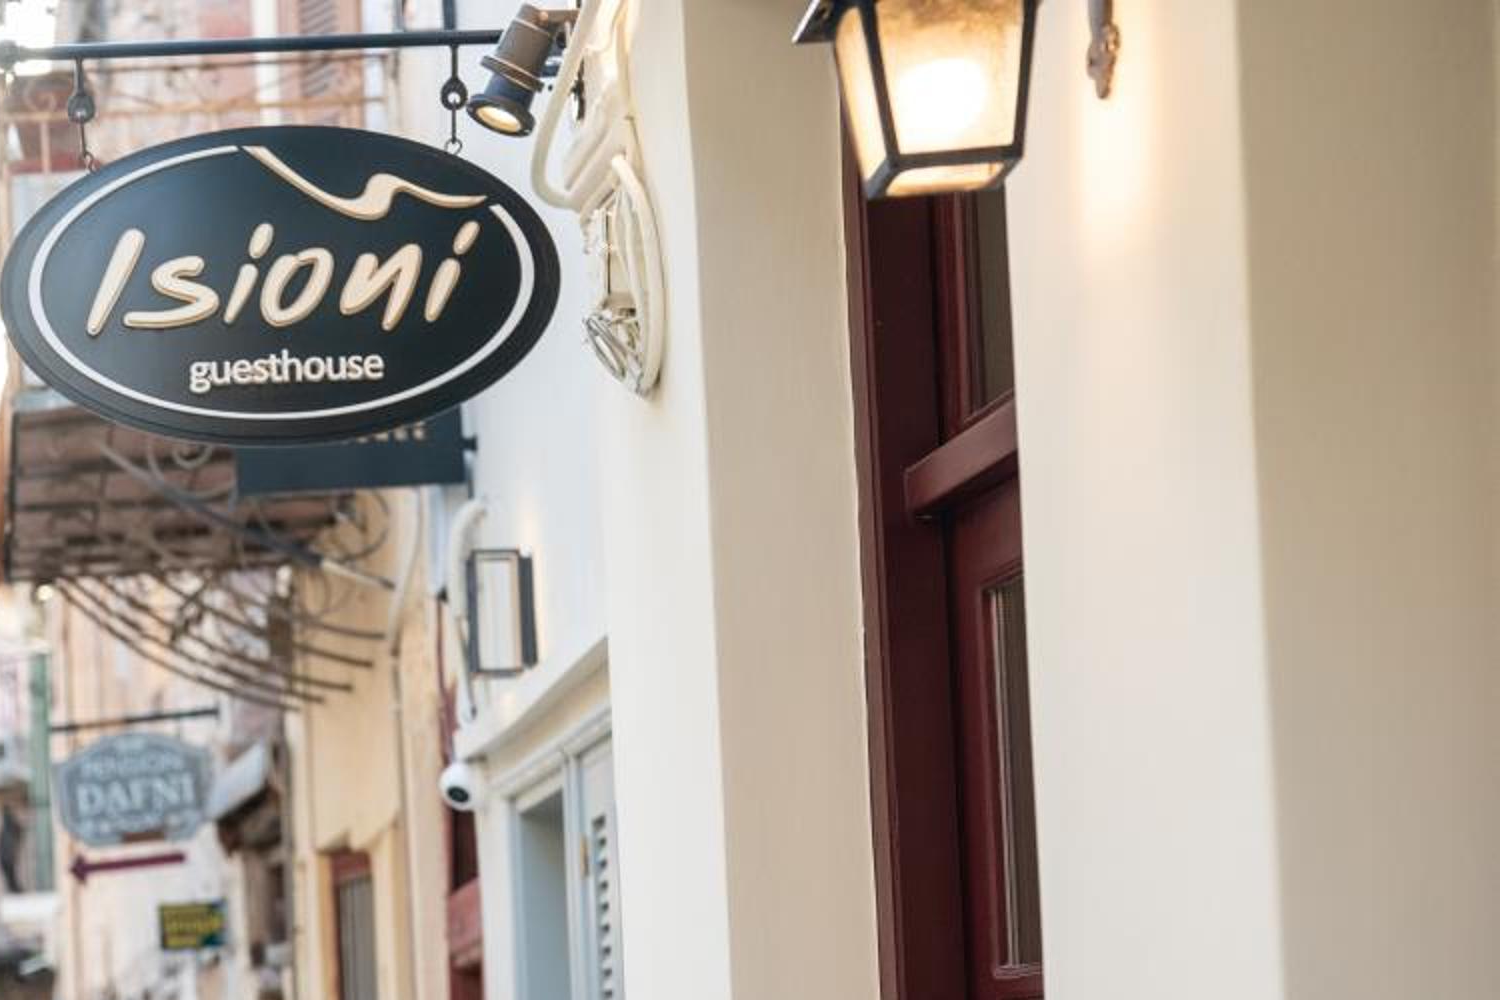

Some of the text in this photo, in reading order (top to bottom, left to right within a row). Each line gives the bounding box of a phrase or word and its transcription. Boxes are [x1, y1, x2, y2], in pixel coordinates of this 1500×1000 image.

[85, 222, 481, 336] Isioni
[189, 349, 385, 393] guesthouse
[77, 773, 195, 817] DAFNI
